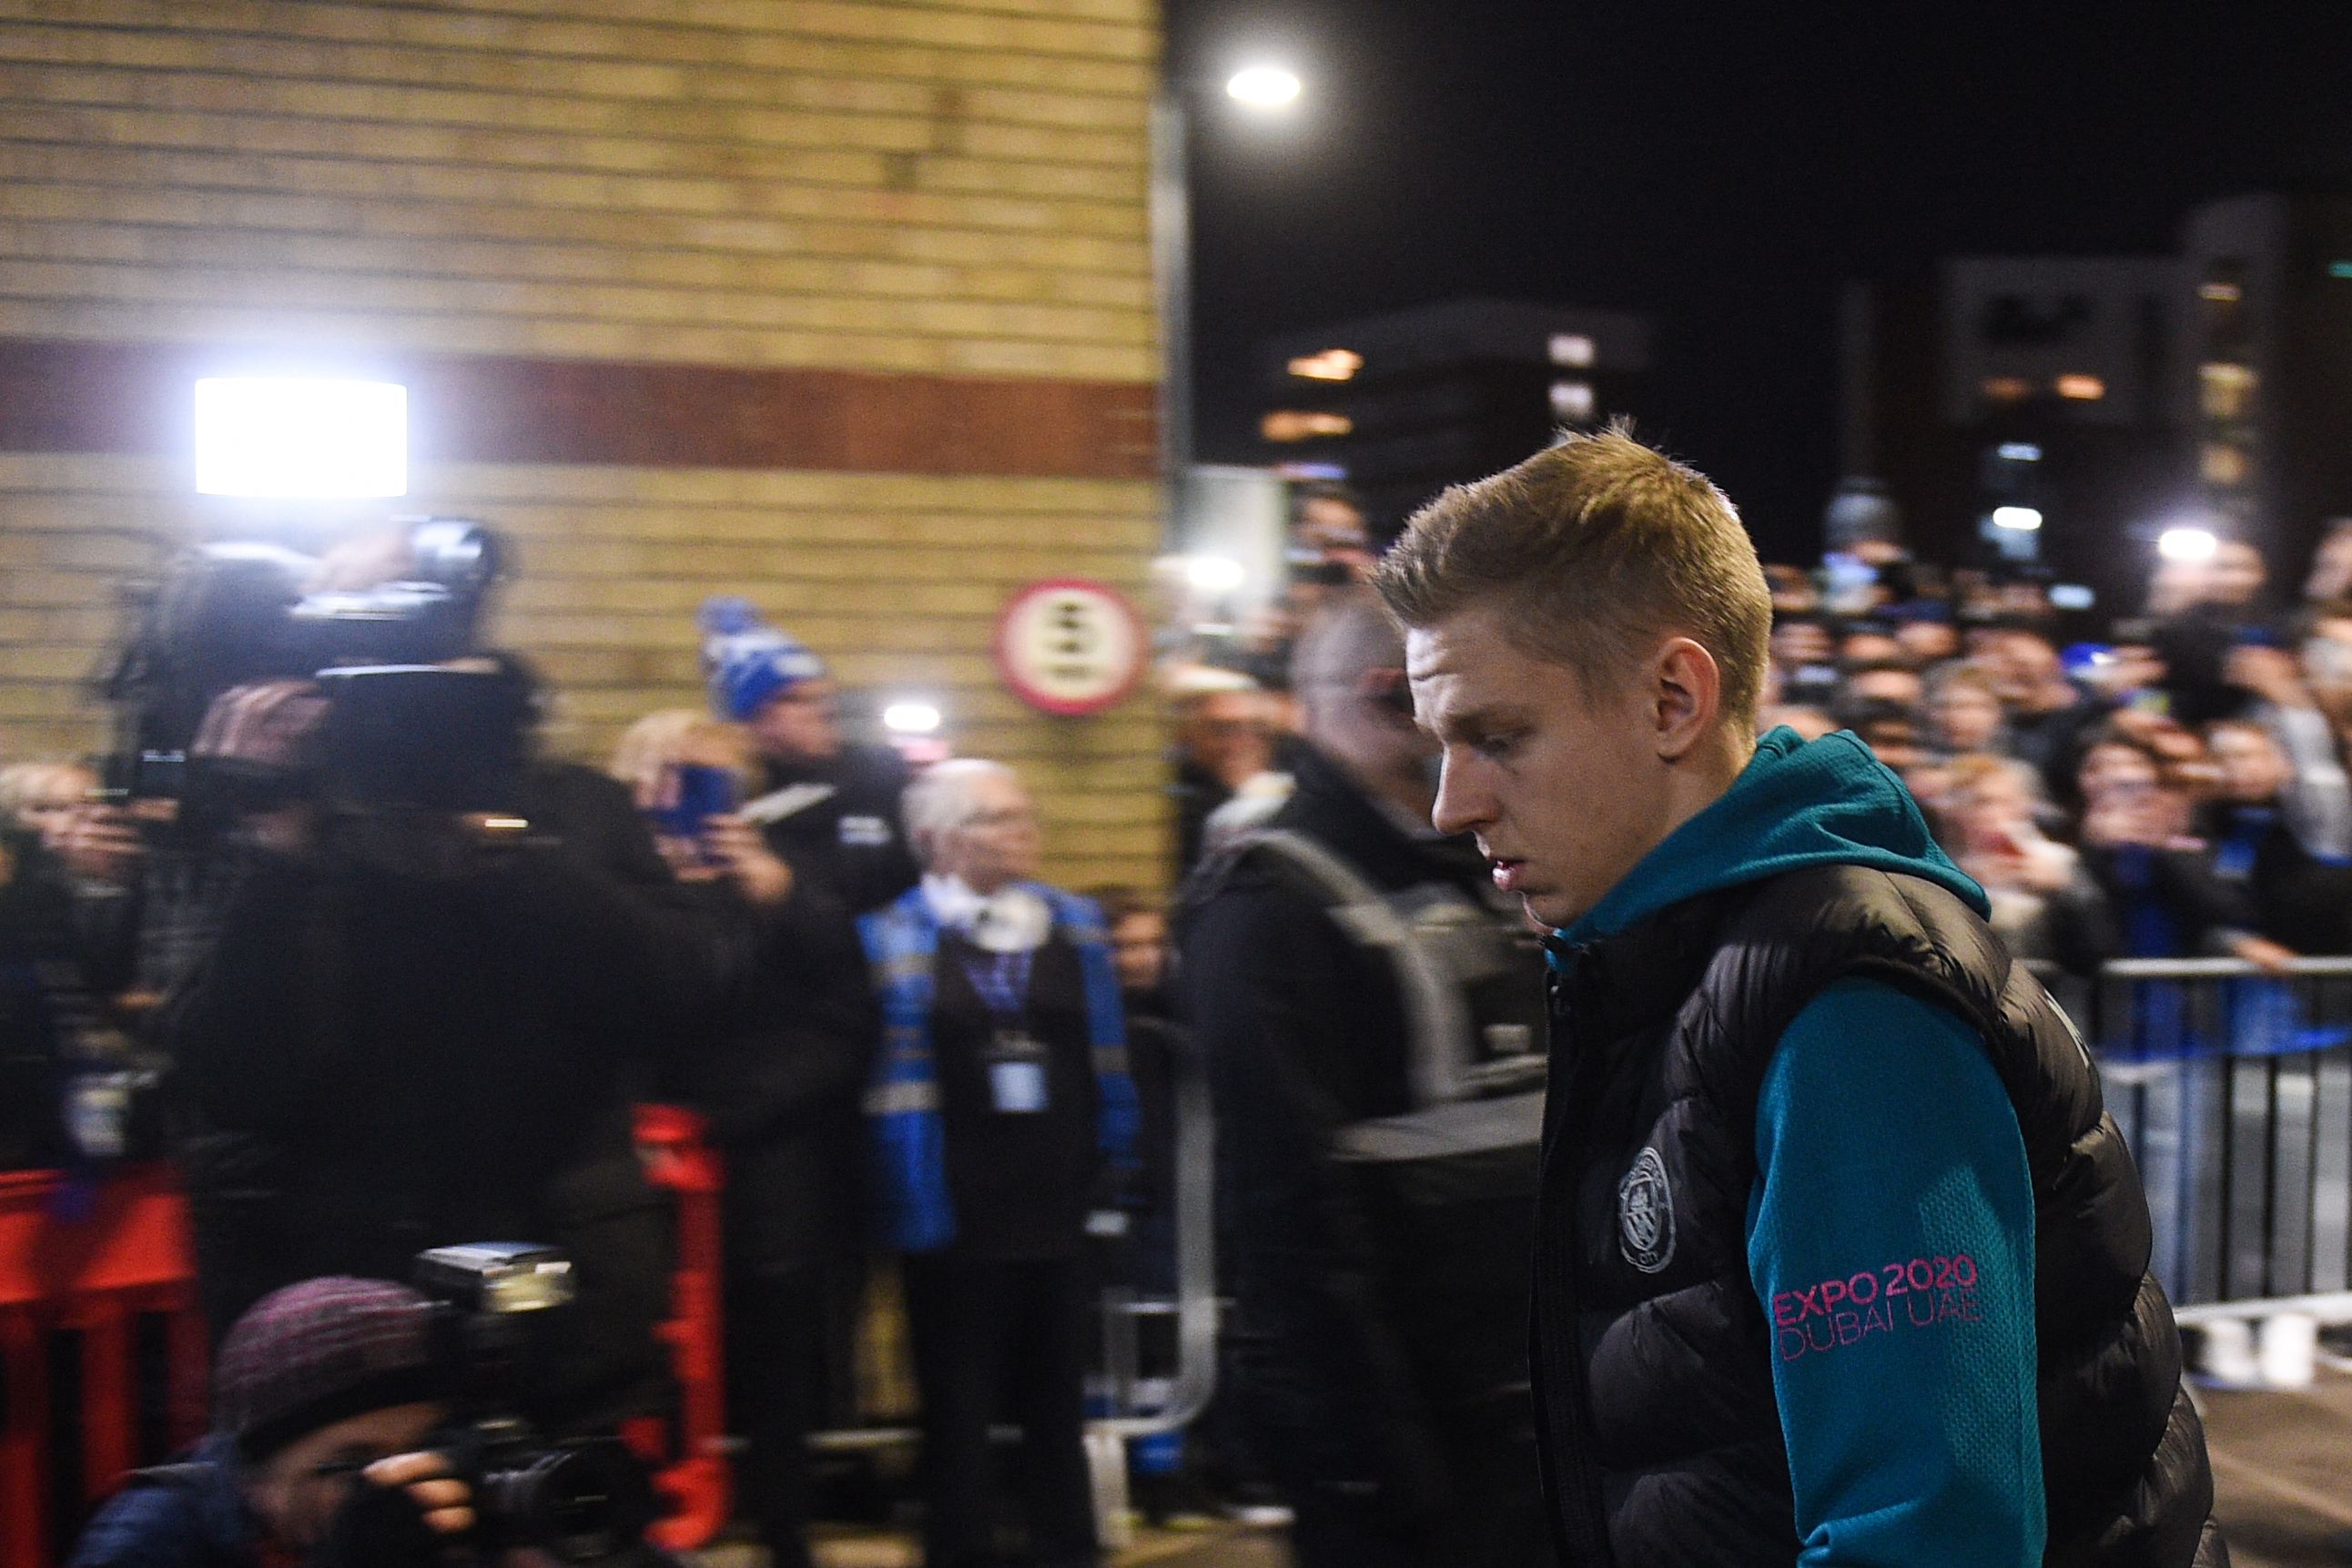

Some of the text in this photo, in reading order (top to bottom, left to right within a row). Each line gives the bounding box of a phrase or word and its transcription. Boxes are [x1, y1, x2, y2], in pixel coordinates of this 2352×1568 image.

[1772, 1253, 1978, 1326] EXPO 2020
[1779, 1285, 1982, 1361] DUBAI UAE
